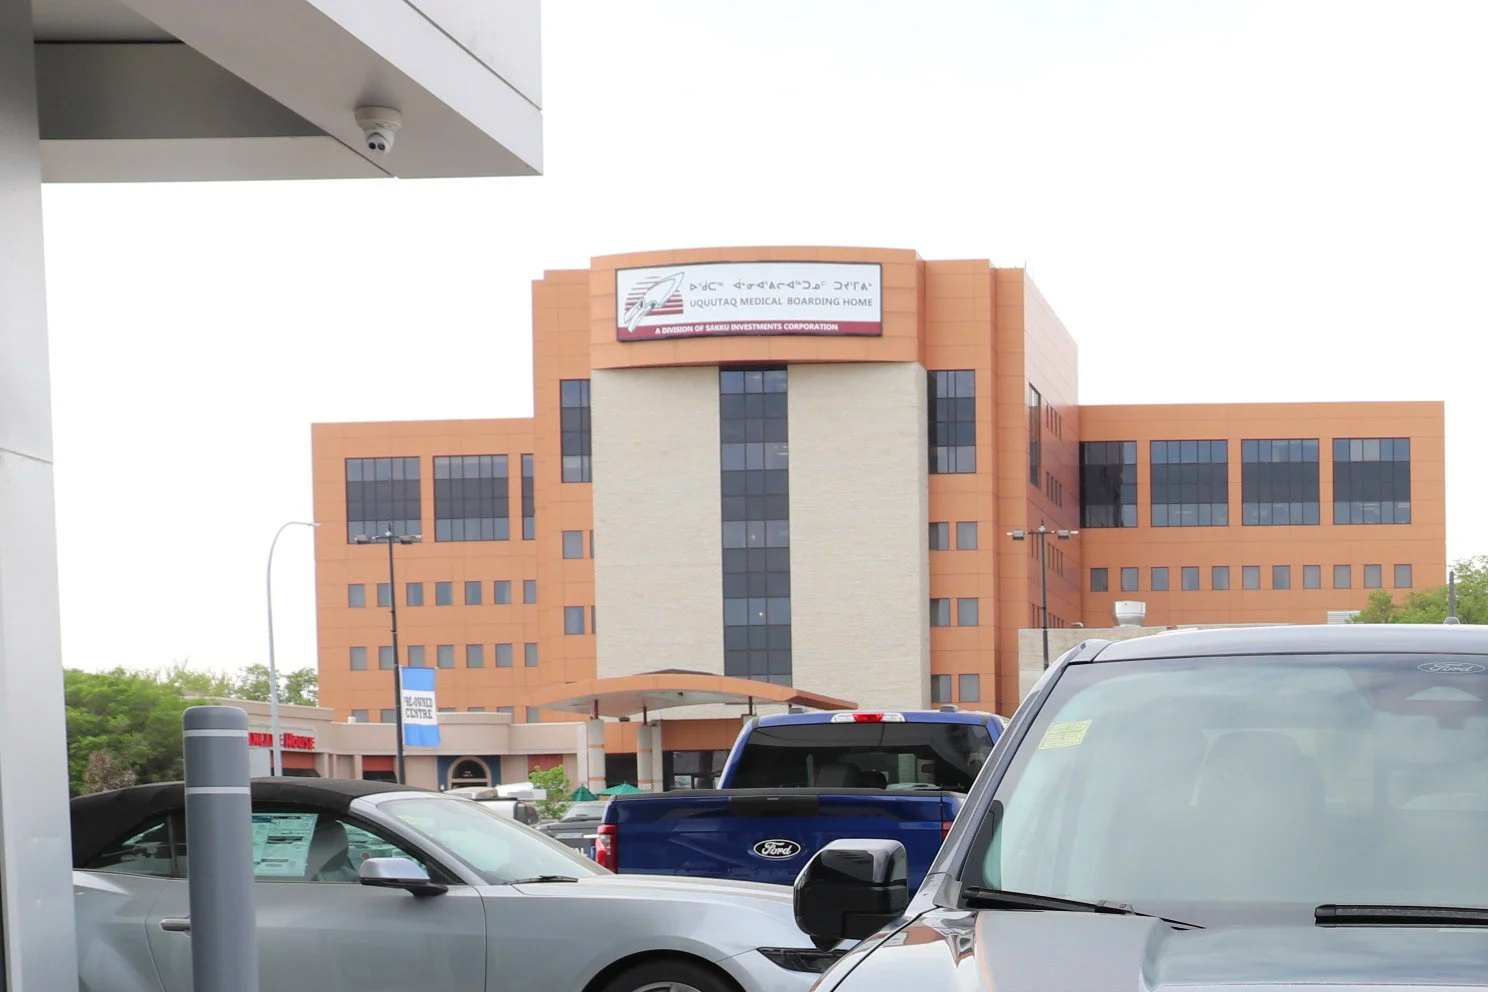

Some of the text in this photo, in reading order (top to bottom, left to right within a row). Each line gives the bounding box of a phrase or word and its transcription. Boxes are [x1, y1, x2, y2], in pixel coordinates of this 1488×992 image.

[689, 297, 873, 308] UQUUTAQ MEDICAL BOARDING HOME
[655, 327, 661, 335] A
[662, 325, 693, 334] DIVISION
[730, 322, 783, 331] INVESTMENTS
[783, 322, 839, 331] CORPORATION
[405, 708, 433, 719] CENTRE
[761, 841, 793, 855] Ford
